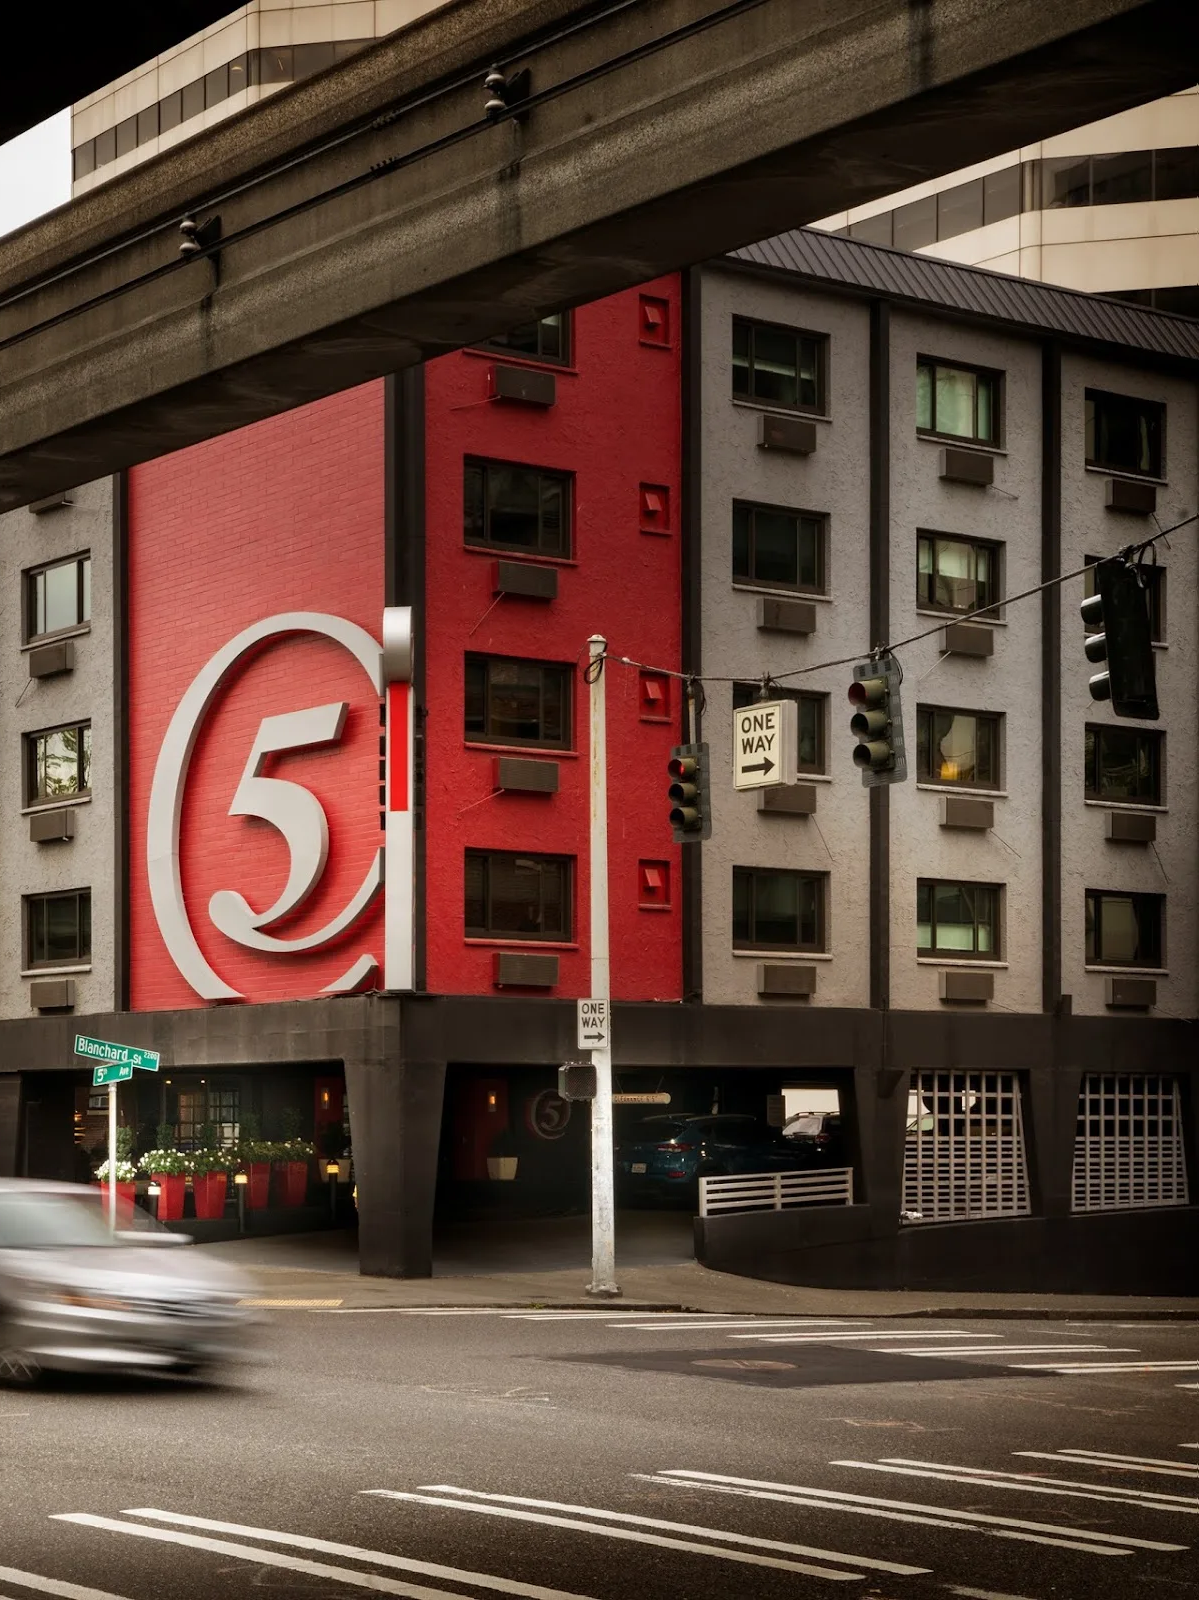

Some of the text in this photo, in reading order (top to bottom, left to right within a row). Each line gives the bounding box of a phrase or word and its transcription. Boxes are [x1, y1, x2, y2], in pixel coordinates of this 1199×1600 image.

[741, 712, 775, 734] ONE
[741, 733, 775, 755] WAY
[581, 1003, 605, 1014] ONE
[581, 1017, 605, 1028] WAY
[77, 1037, 129, 1061] Blanchard
[133, 1053, 142, 1065] St
[119, 1066, 130, 1077] Ave
